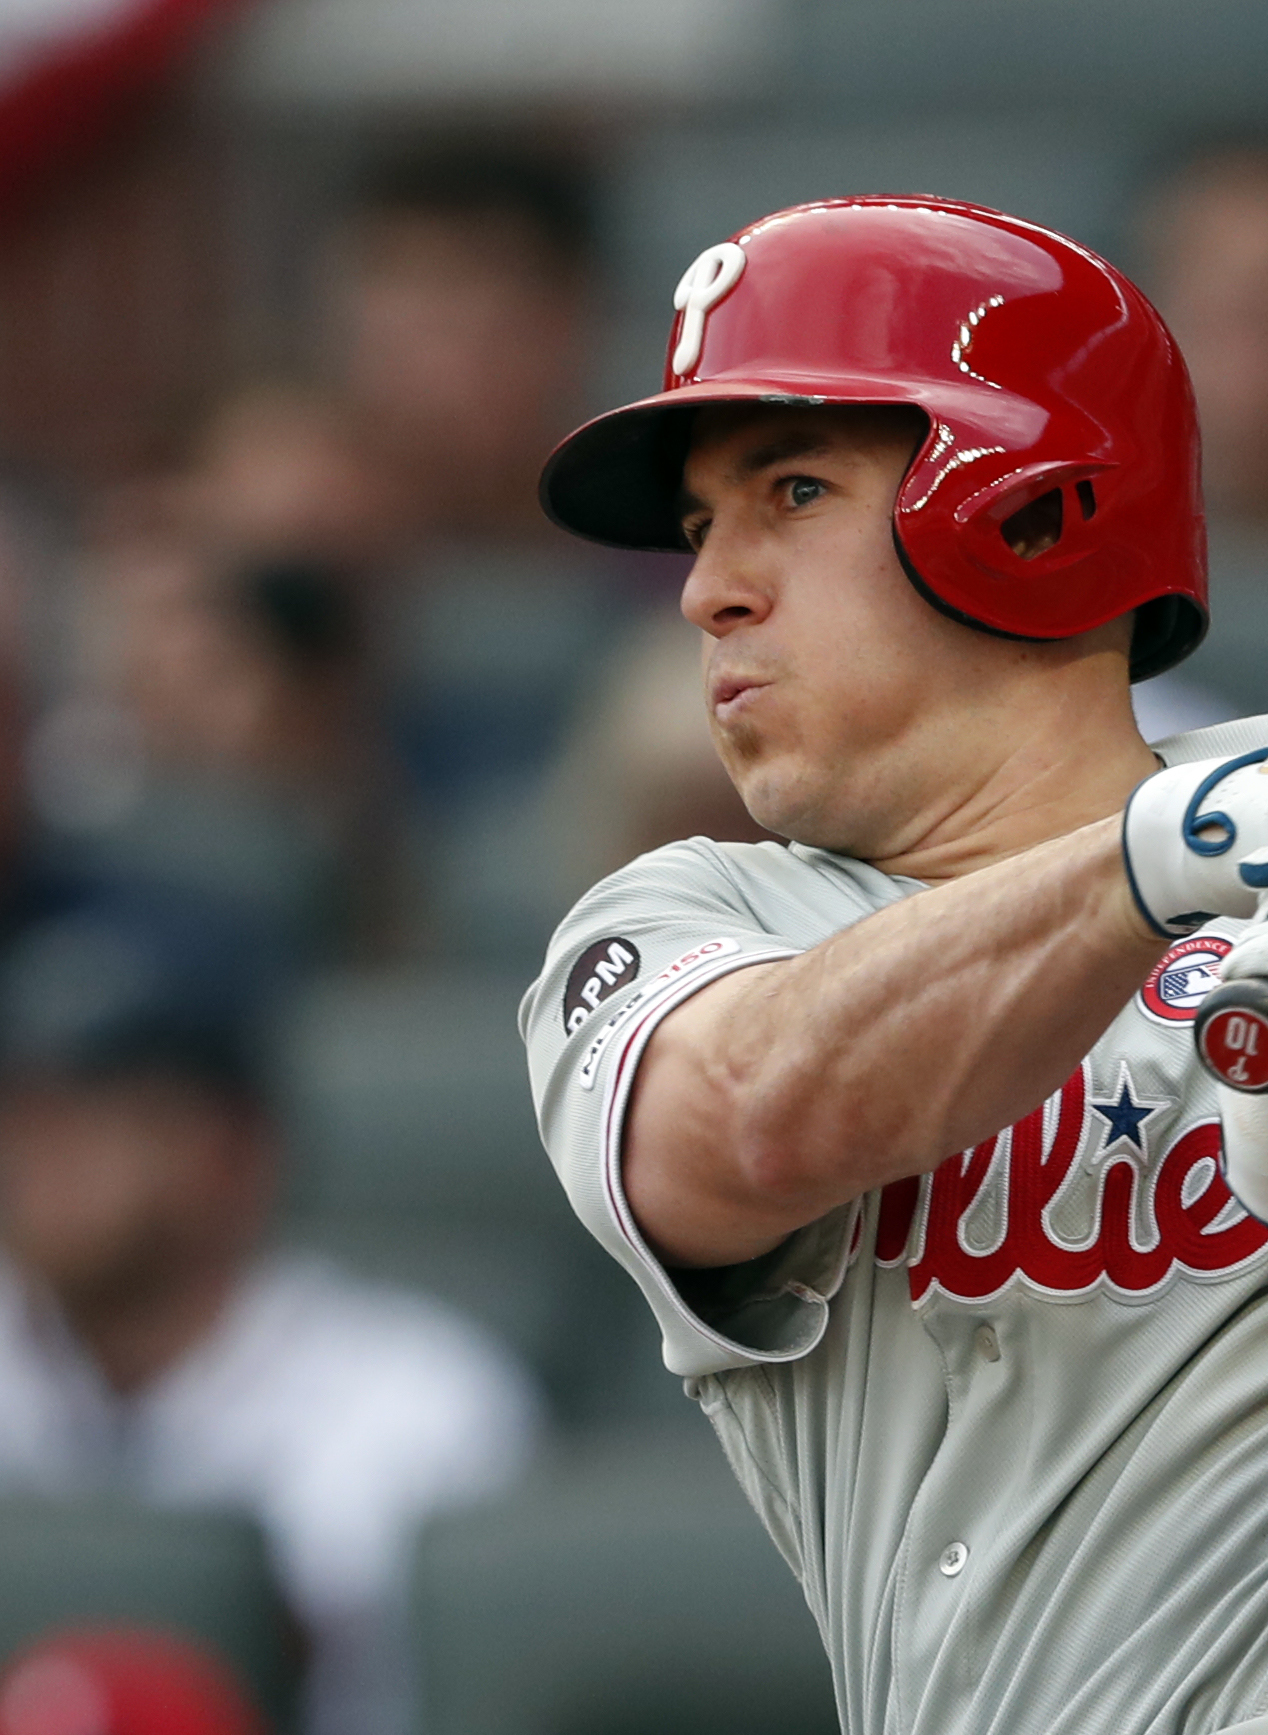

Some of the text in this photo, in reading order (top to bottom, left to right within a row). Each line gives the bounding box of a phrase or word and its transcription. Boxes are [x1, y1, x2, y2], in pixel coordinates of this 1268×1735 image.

[672, 242, 747, 376] P
[1145, 940, 1228, 988] INDEPENDENCE
[1224, 1016, 1260, 1056] 10
